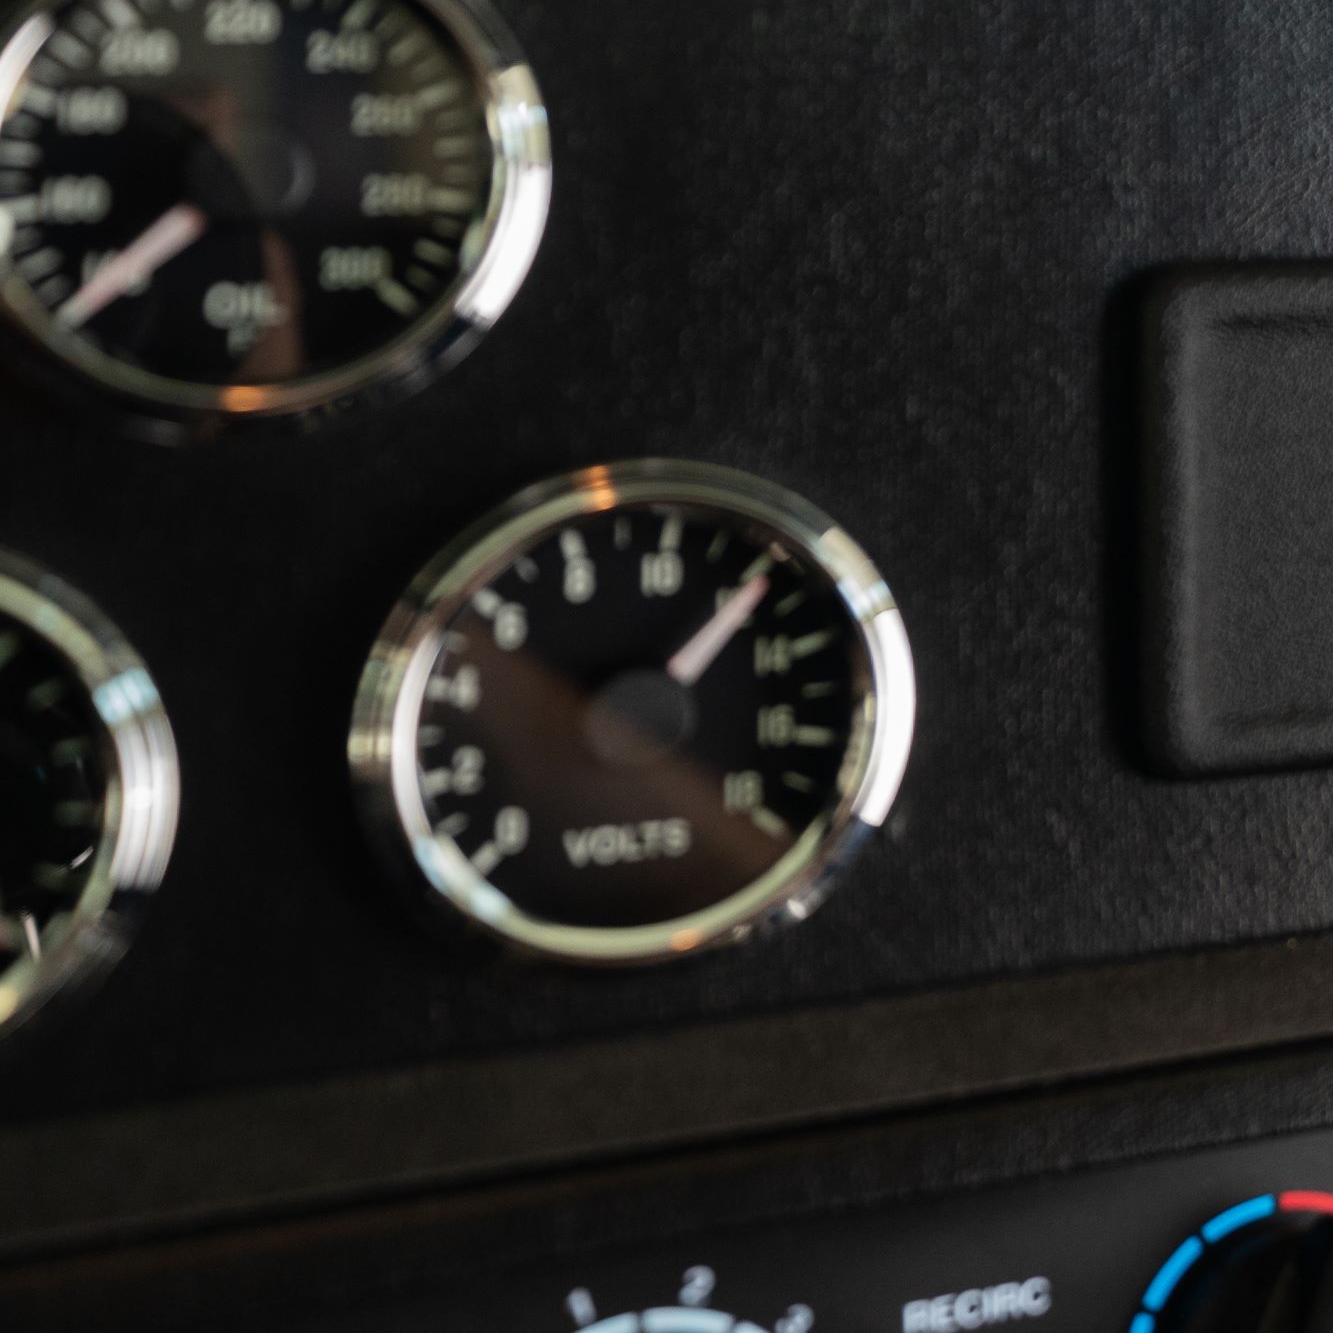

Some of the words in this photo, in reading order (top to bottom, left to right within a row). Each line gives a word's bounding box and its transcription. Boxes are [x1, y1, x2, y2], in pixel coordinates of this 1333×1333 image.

[641, 552, 684, 597] 10
[563, 817, 691, 867] VOLTS
[902, 1275, 1053, 1333] RECIRC
